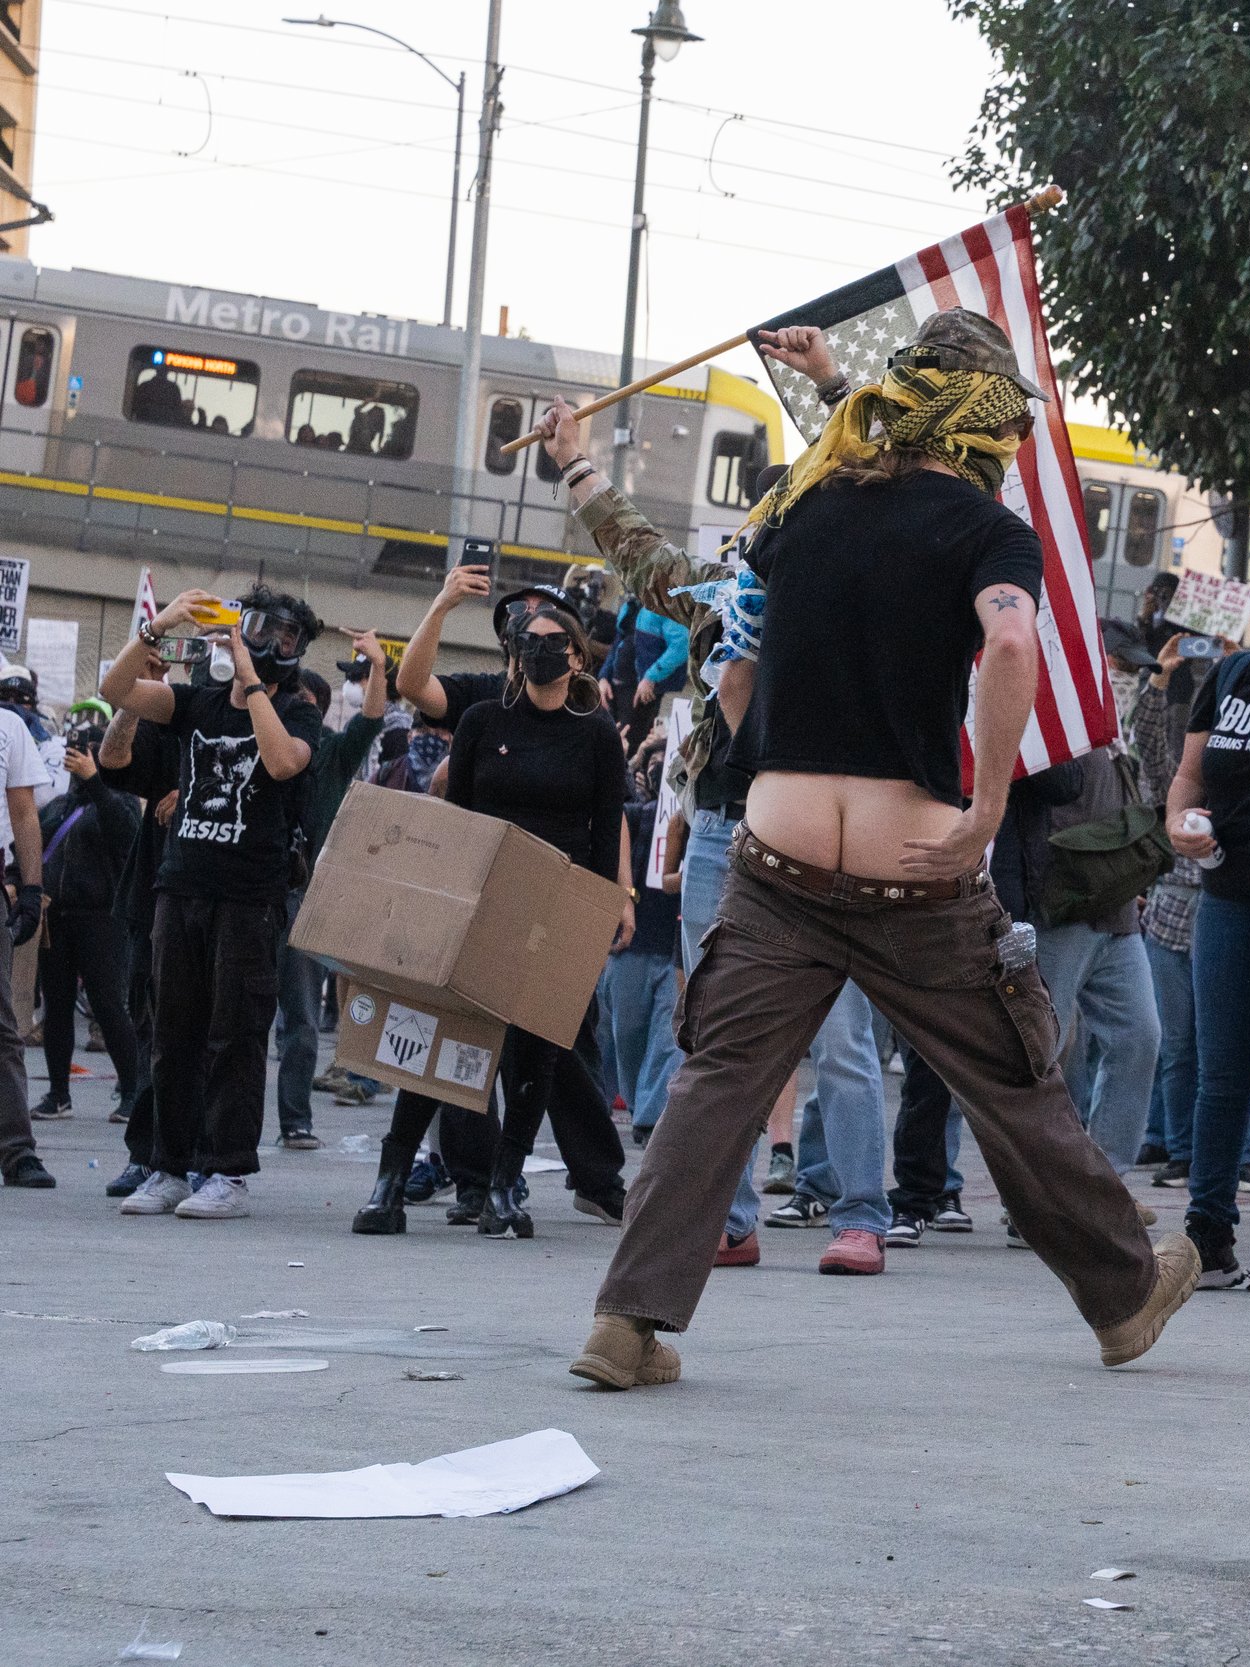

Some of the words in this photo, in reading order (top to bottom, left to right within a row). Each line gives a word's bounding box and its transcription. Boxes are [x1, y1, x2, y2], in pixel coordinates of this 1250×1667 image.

[165, 286, 310, 340] Metro
[325, 312, 410, 357] Rail
[204, 358, 237, 375] NORTH
[178, 818, 247, 844] RESIST
